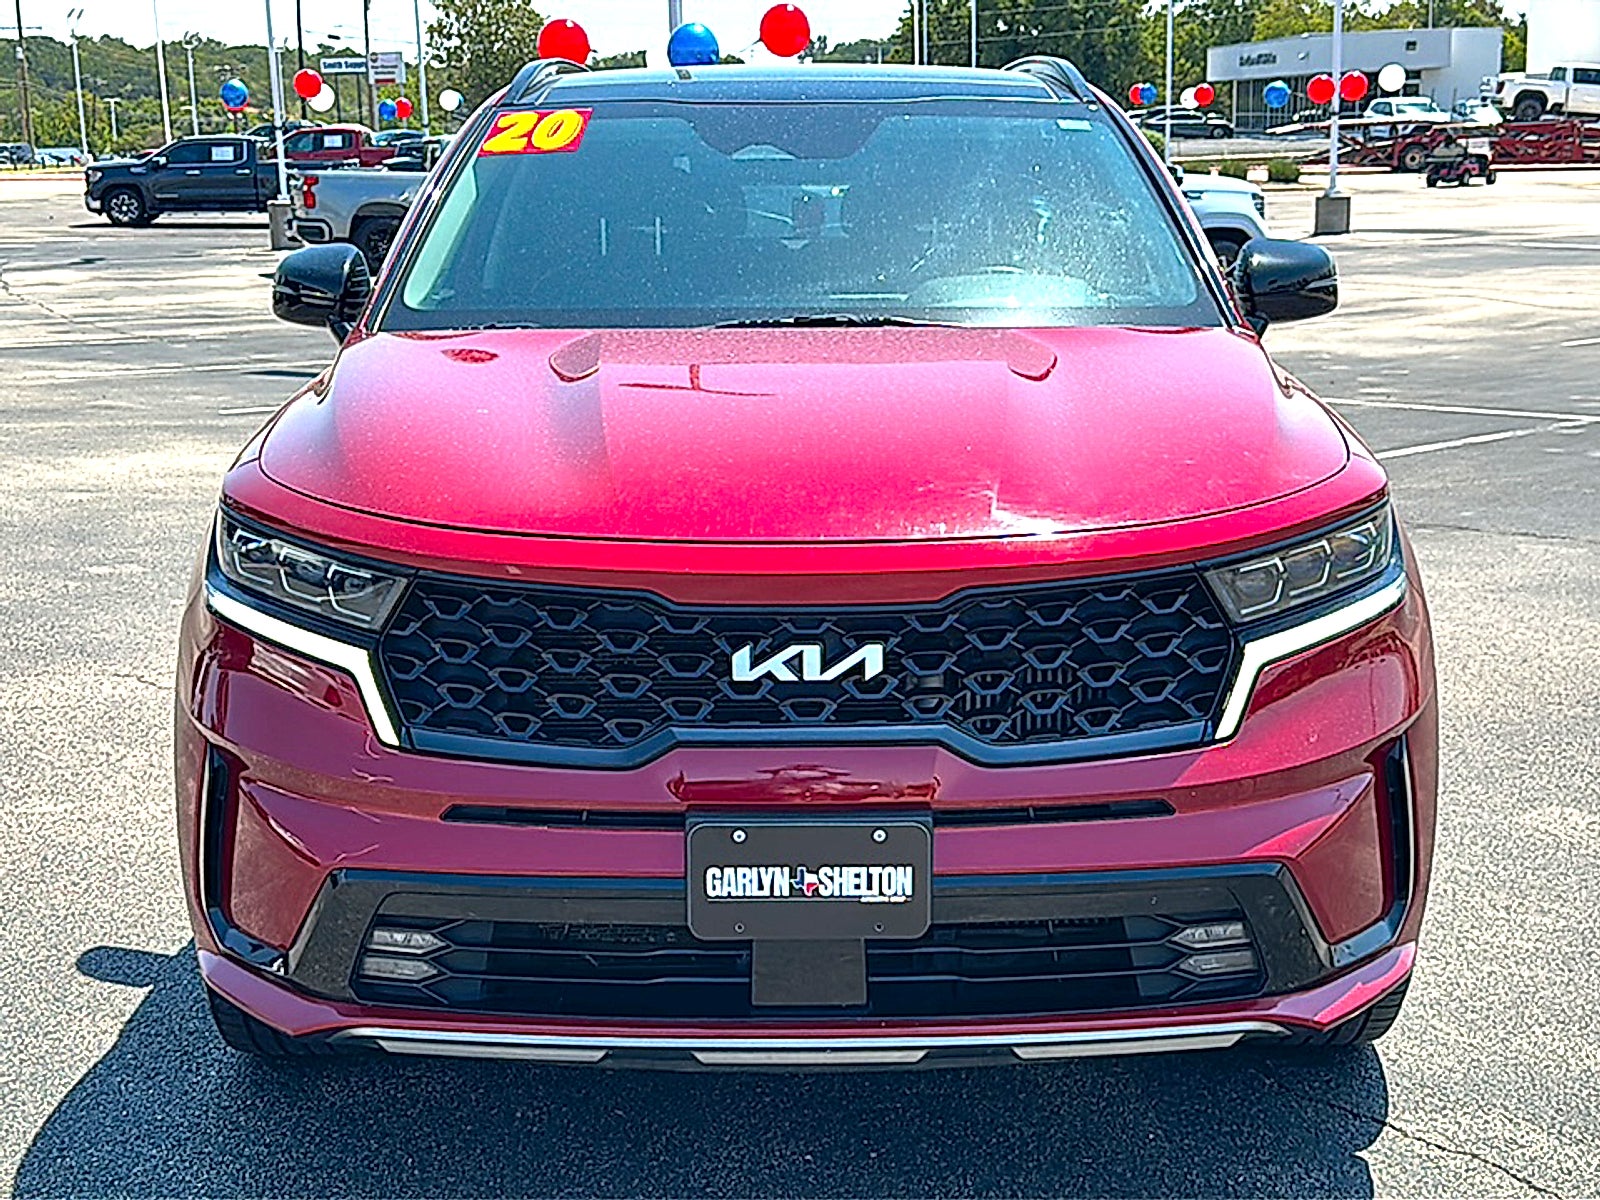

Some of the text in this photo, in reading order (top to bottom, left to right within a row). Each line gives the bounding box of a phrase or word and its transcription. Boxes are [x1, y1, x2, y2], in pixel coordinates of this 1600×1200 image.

[482, 109, 583, 152] 20
[732, 644, 883, 681] KIA
[706, 866, 913, 897] GARLYN SHELTON
